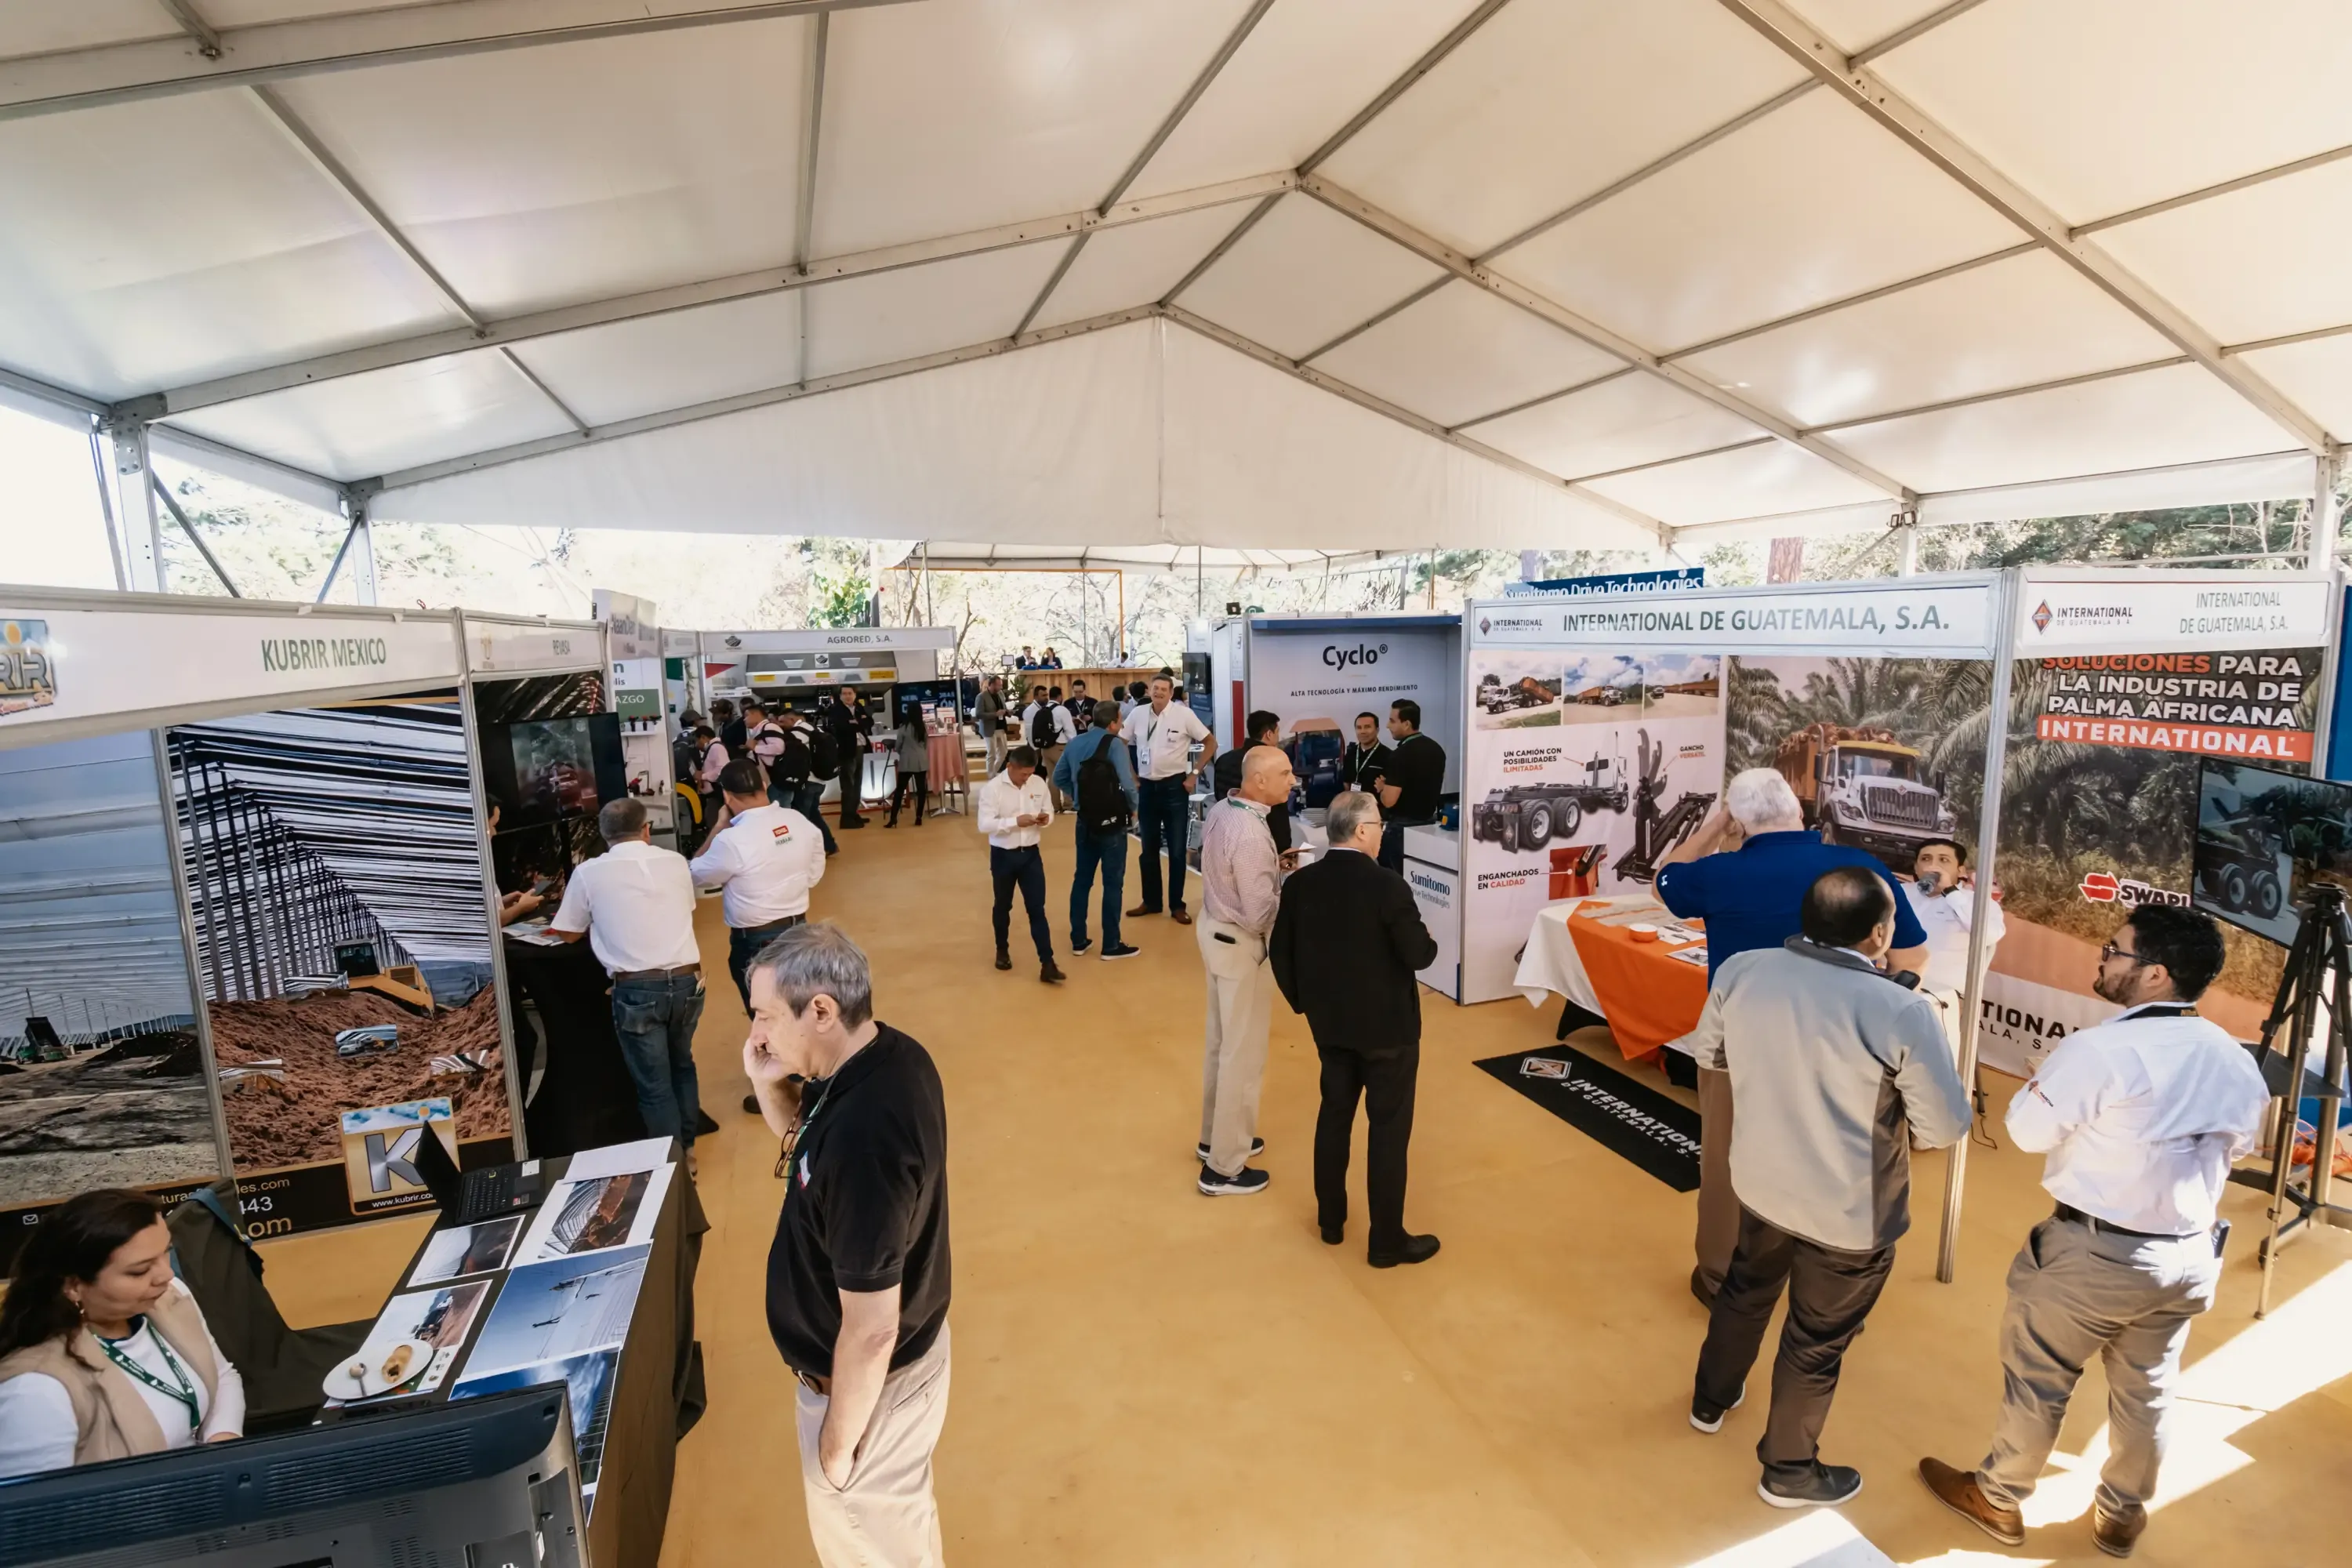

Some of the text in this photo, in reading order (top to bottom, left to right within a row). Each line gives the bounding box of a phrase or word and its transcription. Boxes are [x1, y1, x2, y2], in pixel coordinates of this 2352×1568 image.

[2195, 592, 2281, 609] INTERNATIONAL
[1563, 605, 1950, 634] INTERNATIONAL DE GUATEMALA, S.A.
[2057, 607, 2132, 618] INTERNATIONAL
[2180, 615, 2288, 634] DE GUATEMALA, S.A.
[827, 634, 893, 644] AGRORED, S.A.
[261, 637, 387, 672] KUBRIR MEXICO
[2042, 655, 2303, 677] SOLUCIONES PARA
[1307, 688, 1345, 696] TECNOLOGÍA
[2059, 674, 2302, 702] LA INDUSTRIA DE
[2048, 695, 2298, 728] PALMA AFRICANA
[2041, 719, 2296, 757] INTERNATIONAL
[1504, 756, 1557, 765] POSIBILIDADES
[1516, 748, 1544, 757] CAMIÓN
[1504, 764, 1544, 773] ILIMITADAS
[1410, 870, 1450, 896] Sumitomo
[1478, 869, 1539, 881] ENGANCHADOS
[1490, 878, 1526, 888] CALIDAD
[1980, 1000, 2080, 1040] TIONA
[1560, 1082, 1580, 1092] DE
[1583, 1094, 1668, 1147] GUATEMALA,
[1570, 1079, 1701, 1155] INTERNATION
